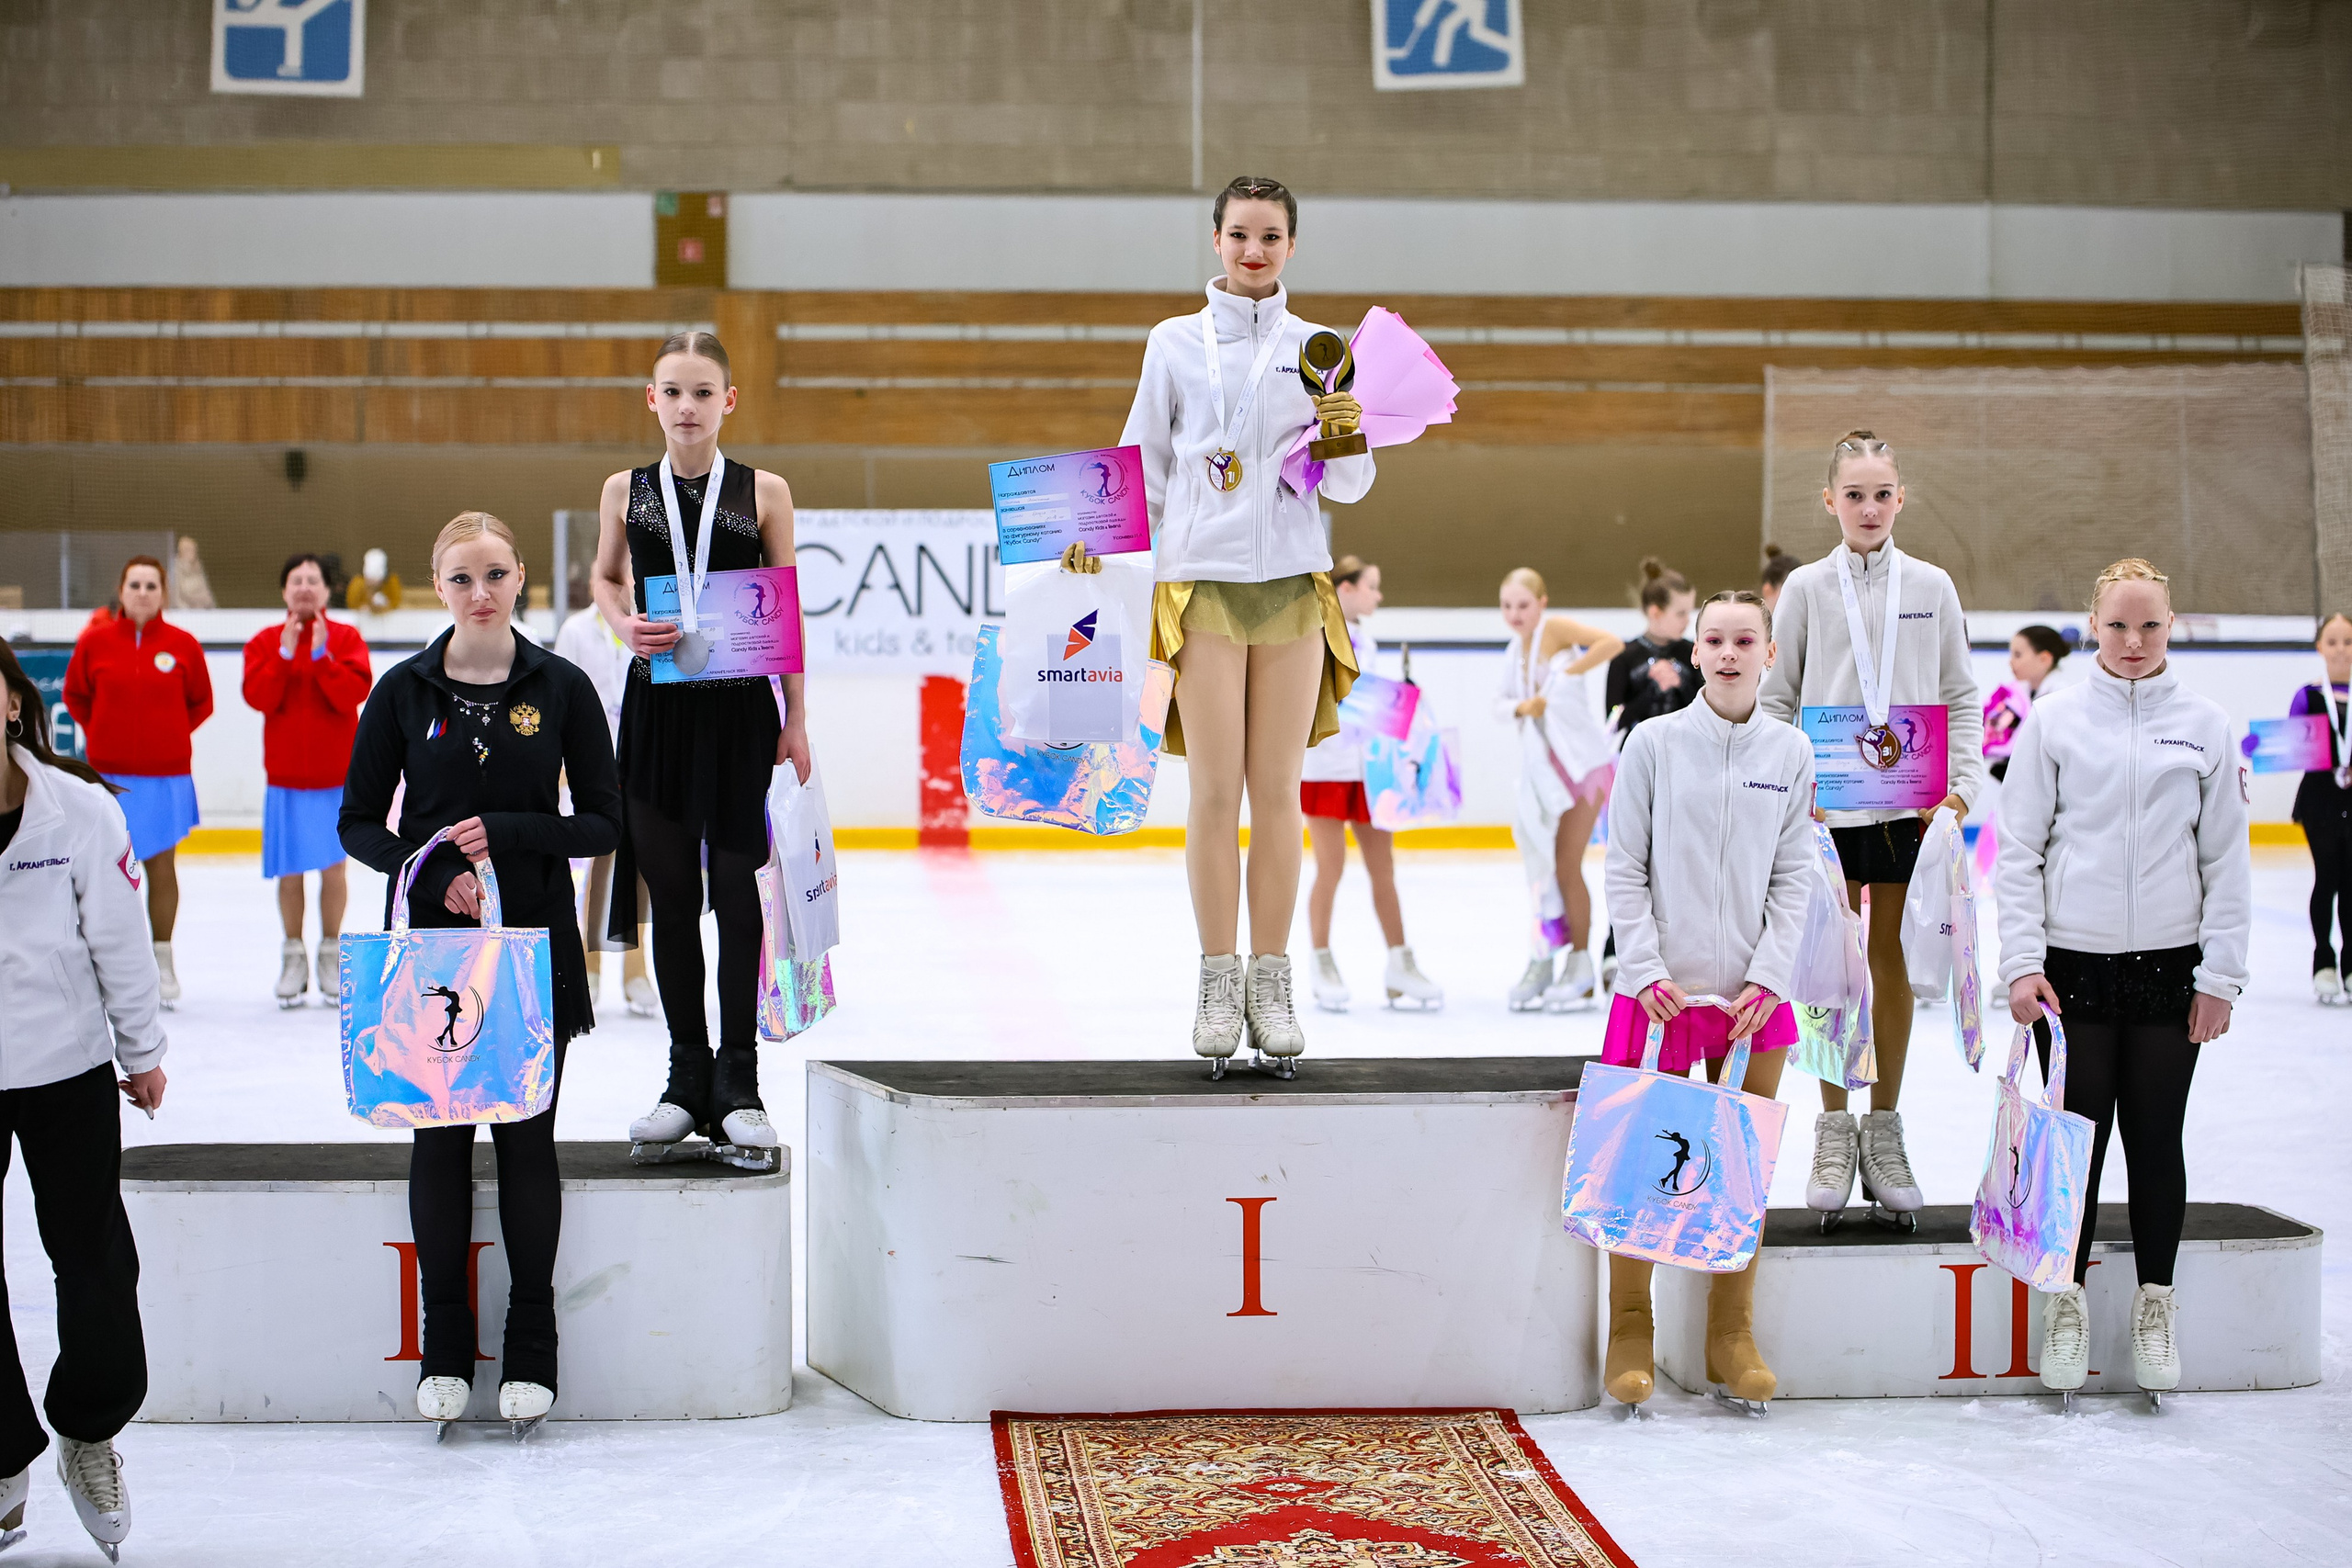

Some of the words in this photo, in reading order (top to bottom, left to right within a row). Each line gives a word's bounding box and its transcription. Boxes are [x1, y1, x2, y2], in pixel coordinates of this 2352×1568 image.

[1898, 612, 1934, 620] ХАНГЕЛЬСК
[833, 627, 900, 656] kids
[1037, 666, 1123, 682] smartavia
[2160, 739, 2205, 752] АРХАНГЕЛЬСК
[455, 1055, 481, 1063] CANDY
[1646, 1195, 1672, 1206] КУБОК
[1673, 1200, 1698, 1211] CANDY
[1226, 1197, 1277, 1317] I
[1939, 1261, 2101, 1379] II
